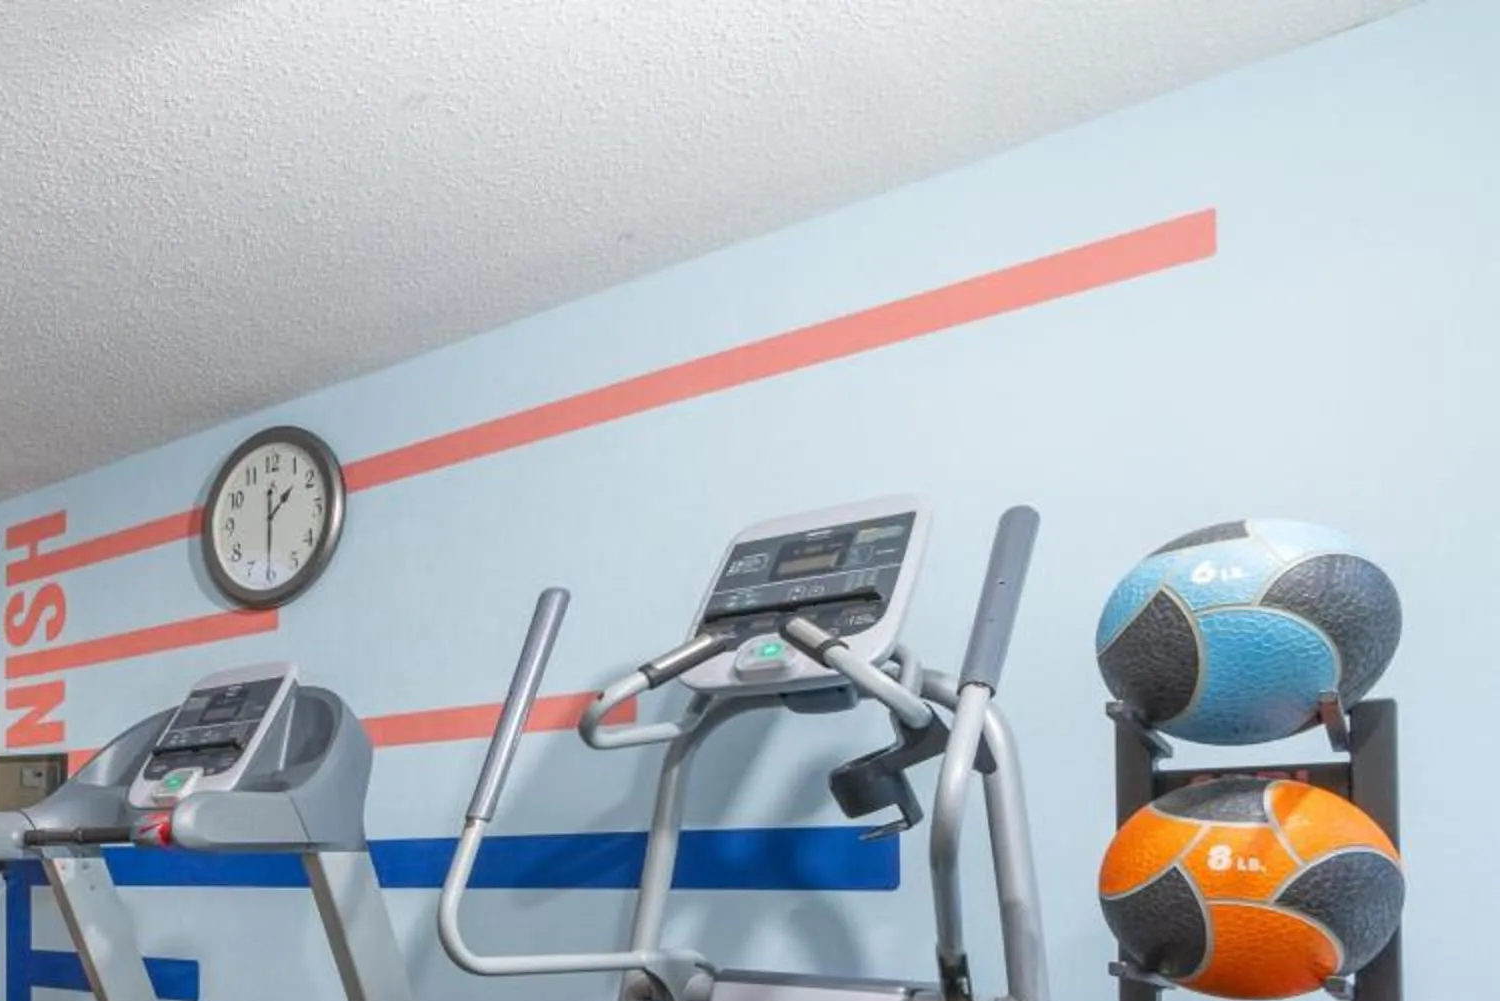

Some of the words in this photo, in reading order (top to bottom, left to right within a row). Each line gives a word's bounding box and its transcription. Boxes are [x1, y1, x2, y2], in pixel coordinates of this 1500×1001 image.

[265, 453, 280, 474] 12
[305, 470, 315, 489] 2
[228, 491, 244, 510] 10
[1192, 560, 1215, 584] 6
[1208, 845, 1232, 871] 8
